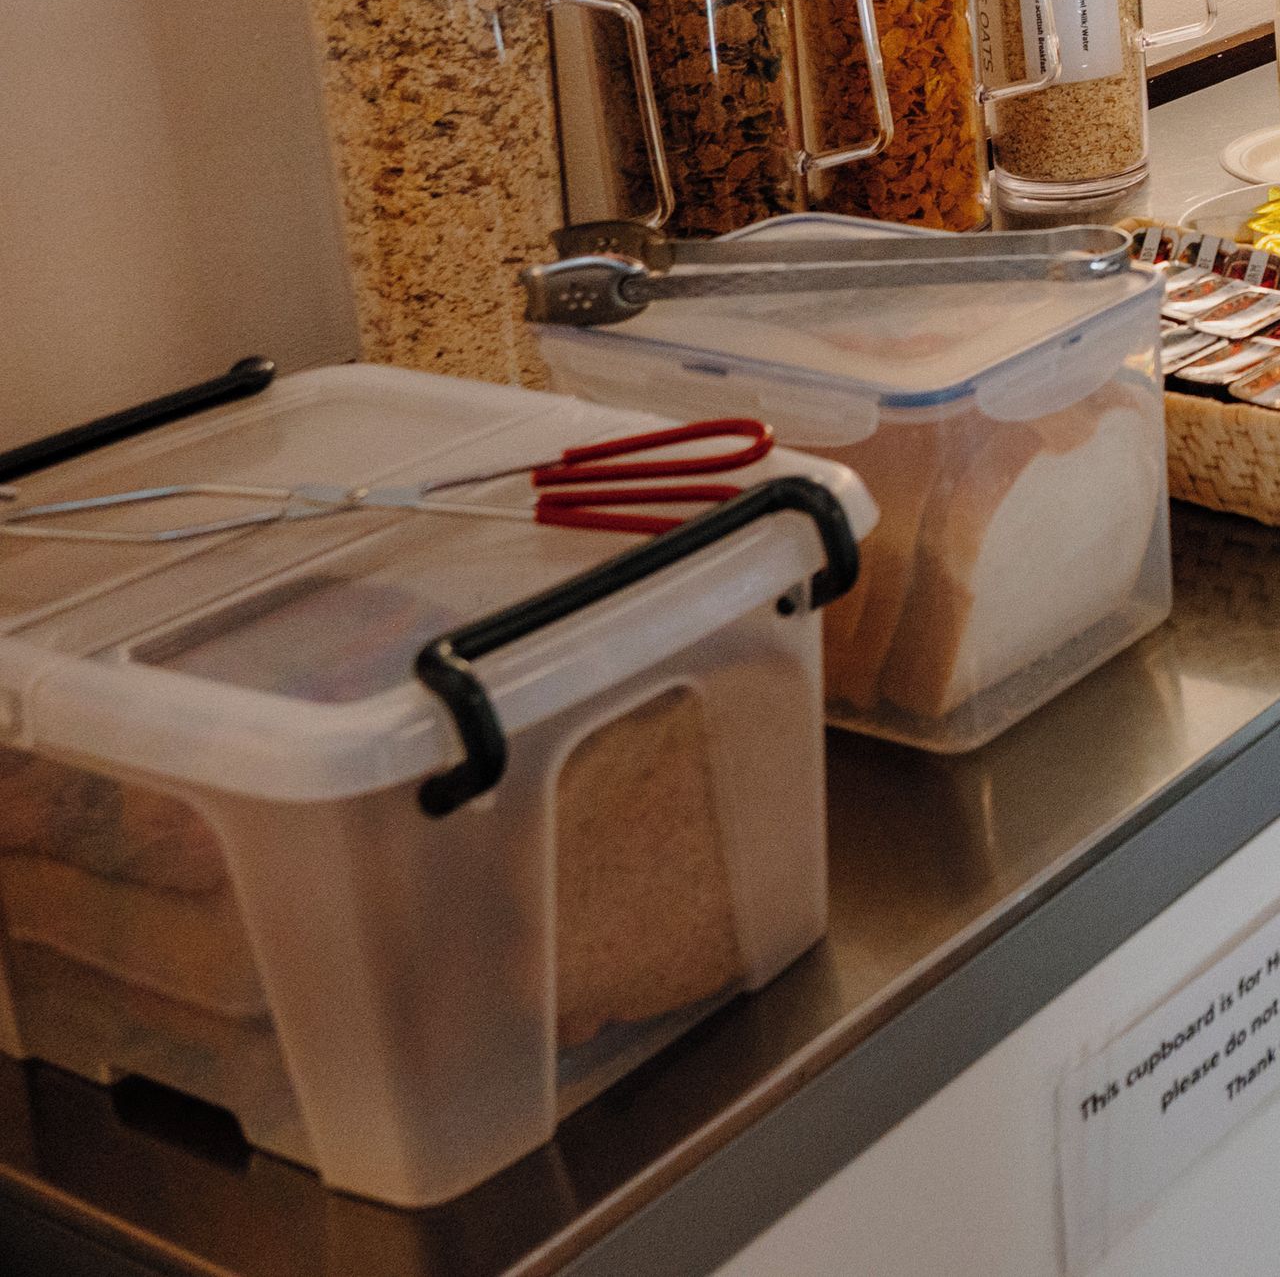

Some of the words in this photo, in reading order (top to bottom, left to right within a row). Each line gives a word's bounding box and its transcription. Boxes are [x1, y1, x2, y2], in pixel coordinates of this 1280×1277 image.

[980, 12, 994, 73] OATS
[1038, 36, 1048, 75] Breakfast.
[1080, 10, 1090, 52] Milk/Water
[1080, 1079, 1120, 1122] This
[1125, 1002, 1215, 1088] cupboard
[1219, 994, 1234, 1013] is
[1237, 970, 1262, 998] for
[1160, 1052, 1220, 1115] please
[1224, 1030, 1247, 1058] do
[1251, 999, 1279, 1035] not
[1225, 1049, 1275, 1102] Thank
